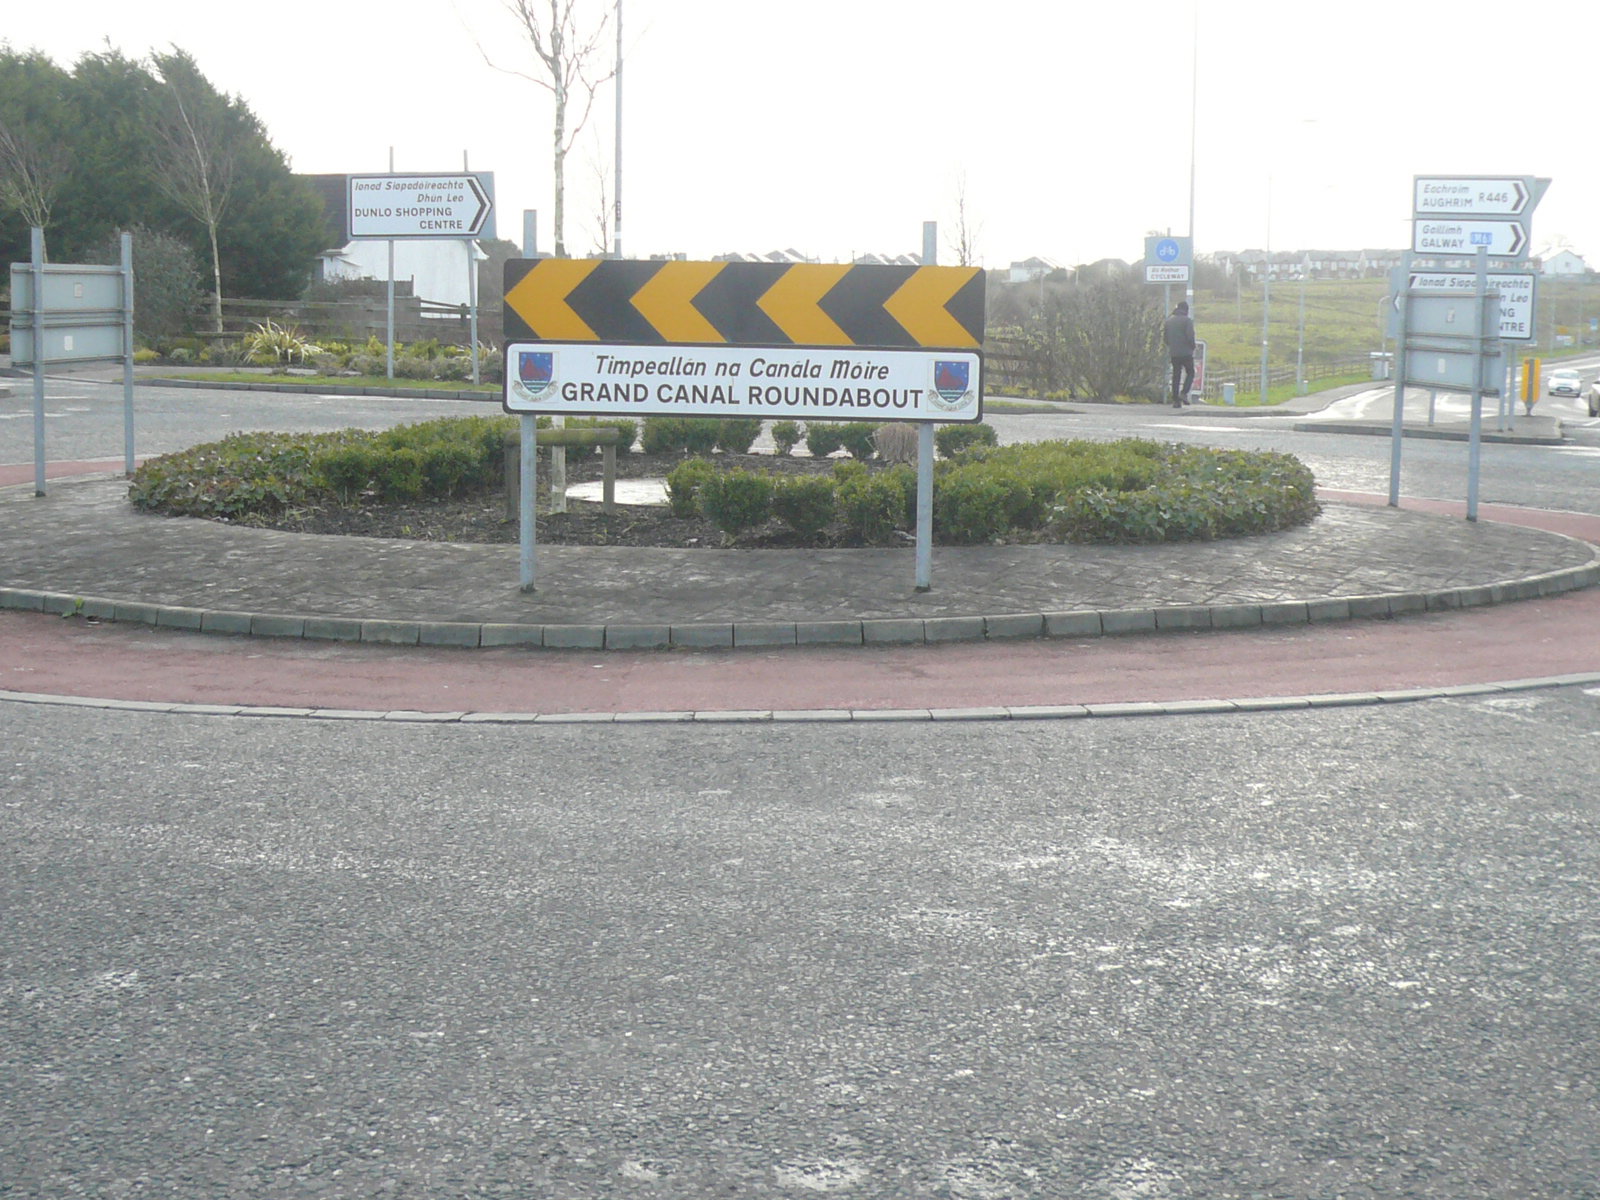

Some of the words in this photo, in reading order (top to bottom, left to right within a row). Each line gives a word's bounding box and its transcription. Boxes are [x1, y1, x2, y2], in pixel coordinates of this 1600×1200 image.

[447, 193, 464, 202] Leo
[1480, 192, 1508, 202] R446
[1423, 198, 1473, 207] AUGHRIM
[355, 208, 392, 217] DUNLO
[395, 207, 452, 216] SHOPPING
[419, 220, 463, 229] CENTRE
[1421, 238, 1465, 248] GALWAY
[596, 355, 707, 378] Timpeallán
[715, 361, 741, 377] na
[749, 358, 822, 379] Canála
[829, 359, 889, 380] Móire
[561, 382, 648, 402] GRAND
[656, 384, 740, 404] CANAL
[748, 386, 923, 408] ROUNDABOUT
